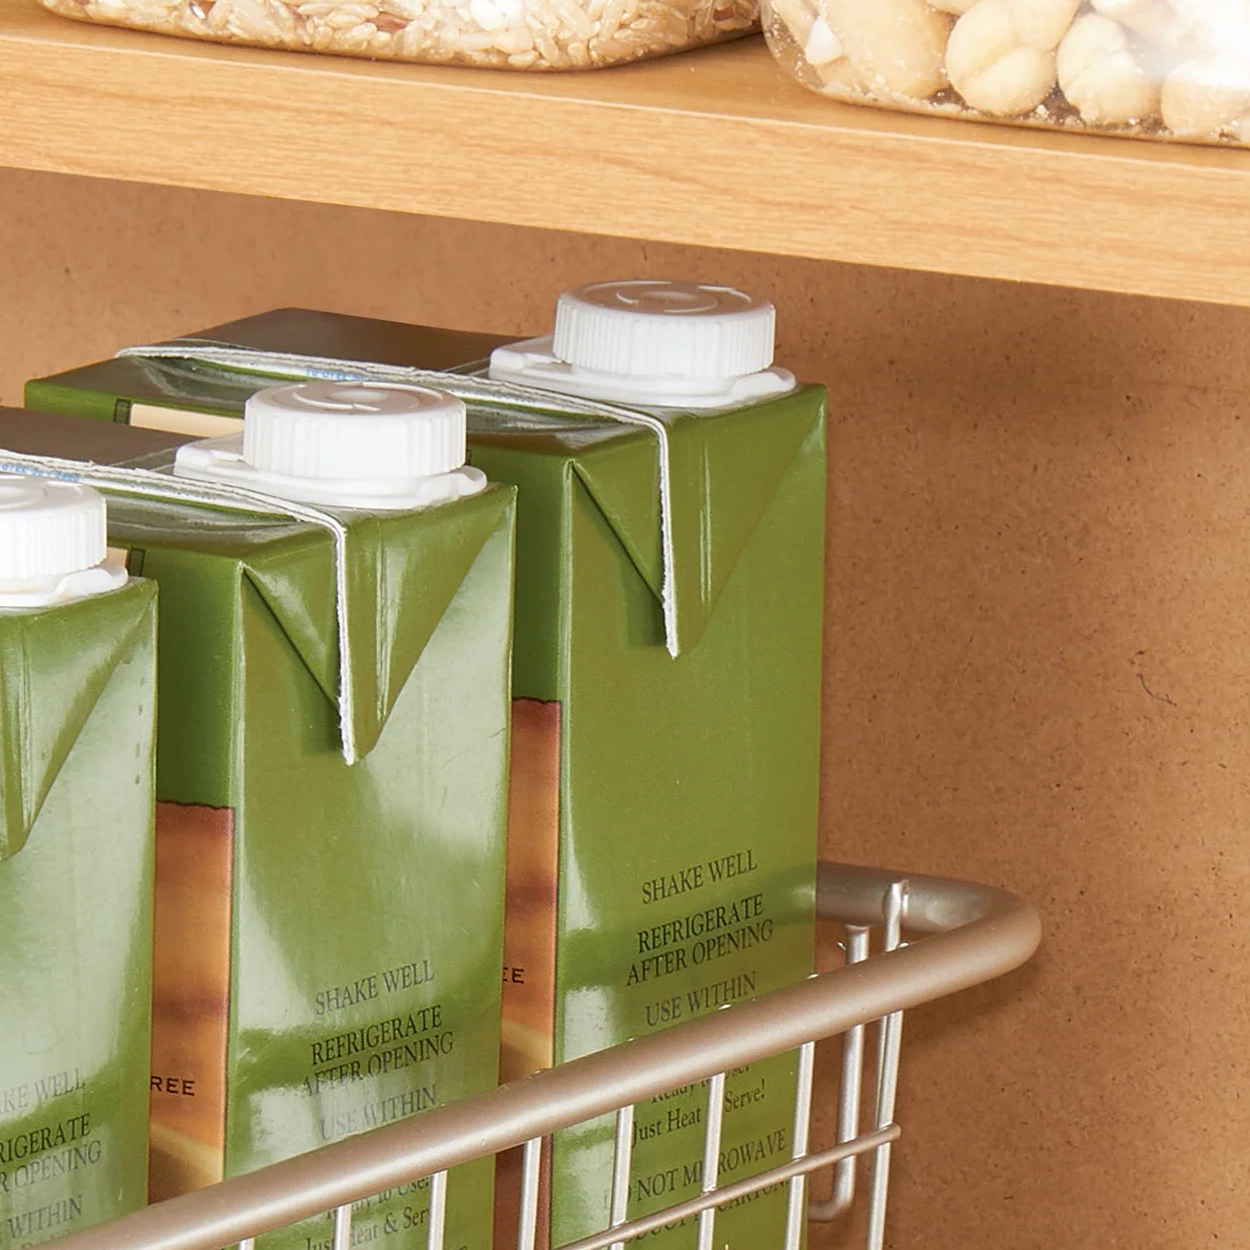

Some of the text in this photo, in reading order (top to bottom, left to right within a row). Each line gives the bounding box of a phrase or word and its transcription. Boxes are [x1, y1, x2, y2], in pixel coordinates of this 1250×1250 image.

[642, 849, 758, 904] SHAKE WELL
[638, 893, 764, 954] REFRIGERATE
[626, 919, 774, 988] AFTER OPENING
[315, 959, 435, 1015] SHAKE WELL
[645, 971, 757, 1027] USE WITHIN
[311, 1005, 443, 1066] REFRIGERATE
[34, 1067, 86, 1101] WELL
[150, 1075, 195, 1096] REE
[302, 1031, 454, 1098] AFTER OPENING
[320, 1084, 436, 1141] USE WITHIN
[632, 1078, 765, 1148] Just Heat Serve!
[13, 1140, 102, 1190] OPENING
[637, 1166, 679, 1203] NOT
[683, 1128, 787, 1188] MIROWAVE
[7, 1194, 83, 1239] WITHIN
[384, 1212, 397, 1235] &
